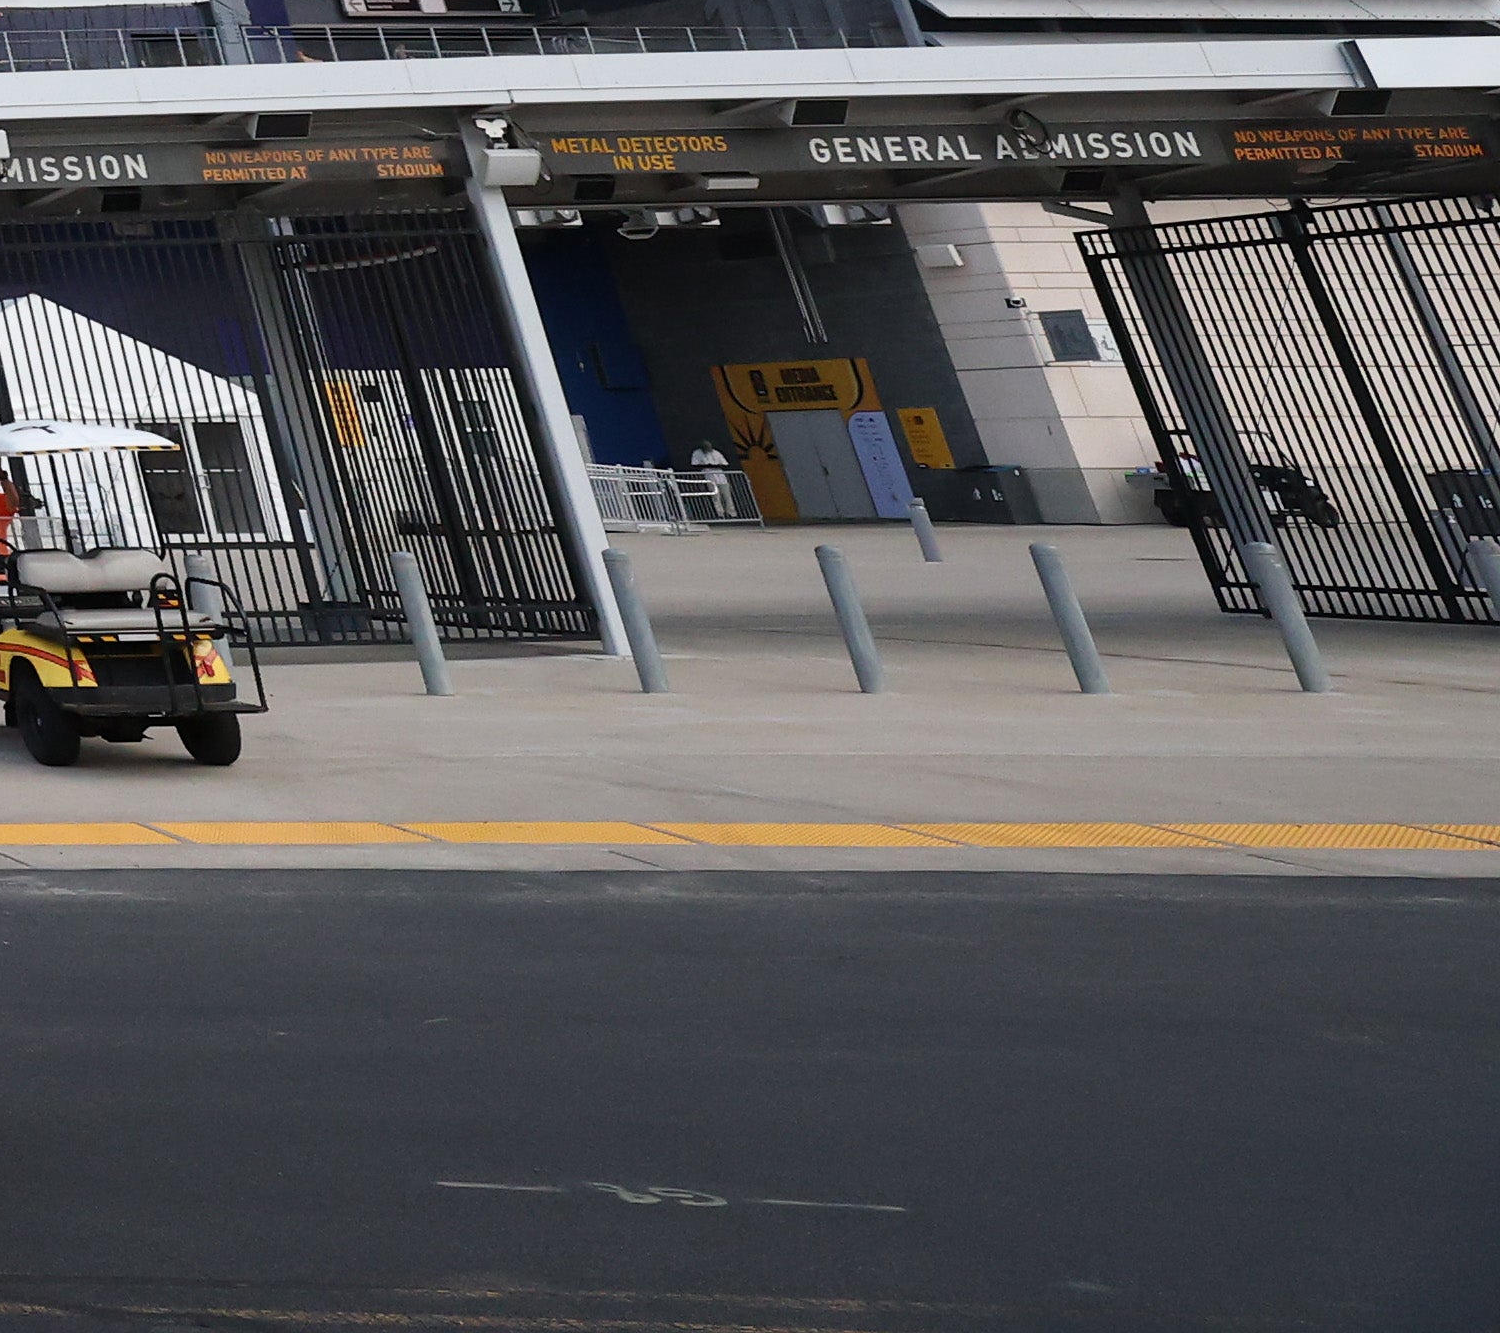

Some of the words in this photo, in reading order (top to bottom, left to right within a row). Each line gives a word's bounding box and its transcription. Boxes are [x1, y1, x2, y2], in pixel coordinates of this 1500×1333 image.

[1235, 130, 1257, 143] NO
[1260, 129, 1334, 143] WEAPONS
[1338, 128, 1358, 141] OF
[1362, 128, 1391, 141] ANY
[1395, 127, 1433, 141] TYPE
[1438, 127, 1469, 140] ARE
[551, 138, 613, 155] METAL
[618, 136, 728, 153] DETECTORS
[809, 134, 982, 164] GENERAL
[995, 130, 1202, 161] ADMISSION
[1235, 145, 1321, 161] PERMITTED
[1325, 145, 1342, 159] AT
[1415, 143, 1483, 159] STADIUM
[205, 152, 227, 164] NO
[230, 150, 302, 164] WEAPONS
[305, 149, 324, 162] OF
[329, 148, 359, 161] ANY
[362, 147, 398, 161] TYPE
[402, 146, 433, 159] ARE
[613, 154, 635, 171] IN
[639, 153, 676, 170] USE
[203, 166, 286, 181] PERMITTED
[289, 166, 307, 179] AT
[378, 162, 443, 178] STADIUM
[775, 385, 838, 404] ENTRANCE
